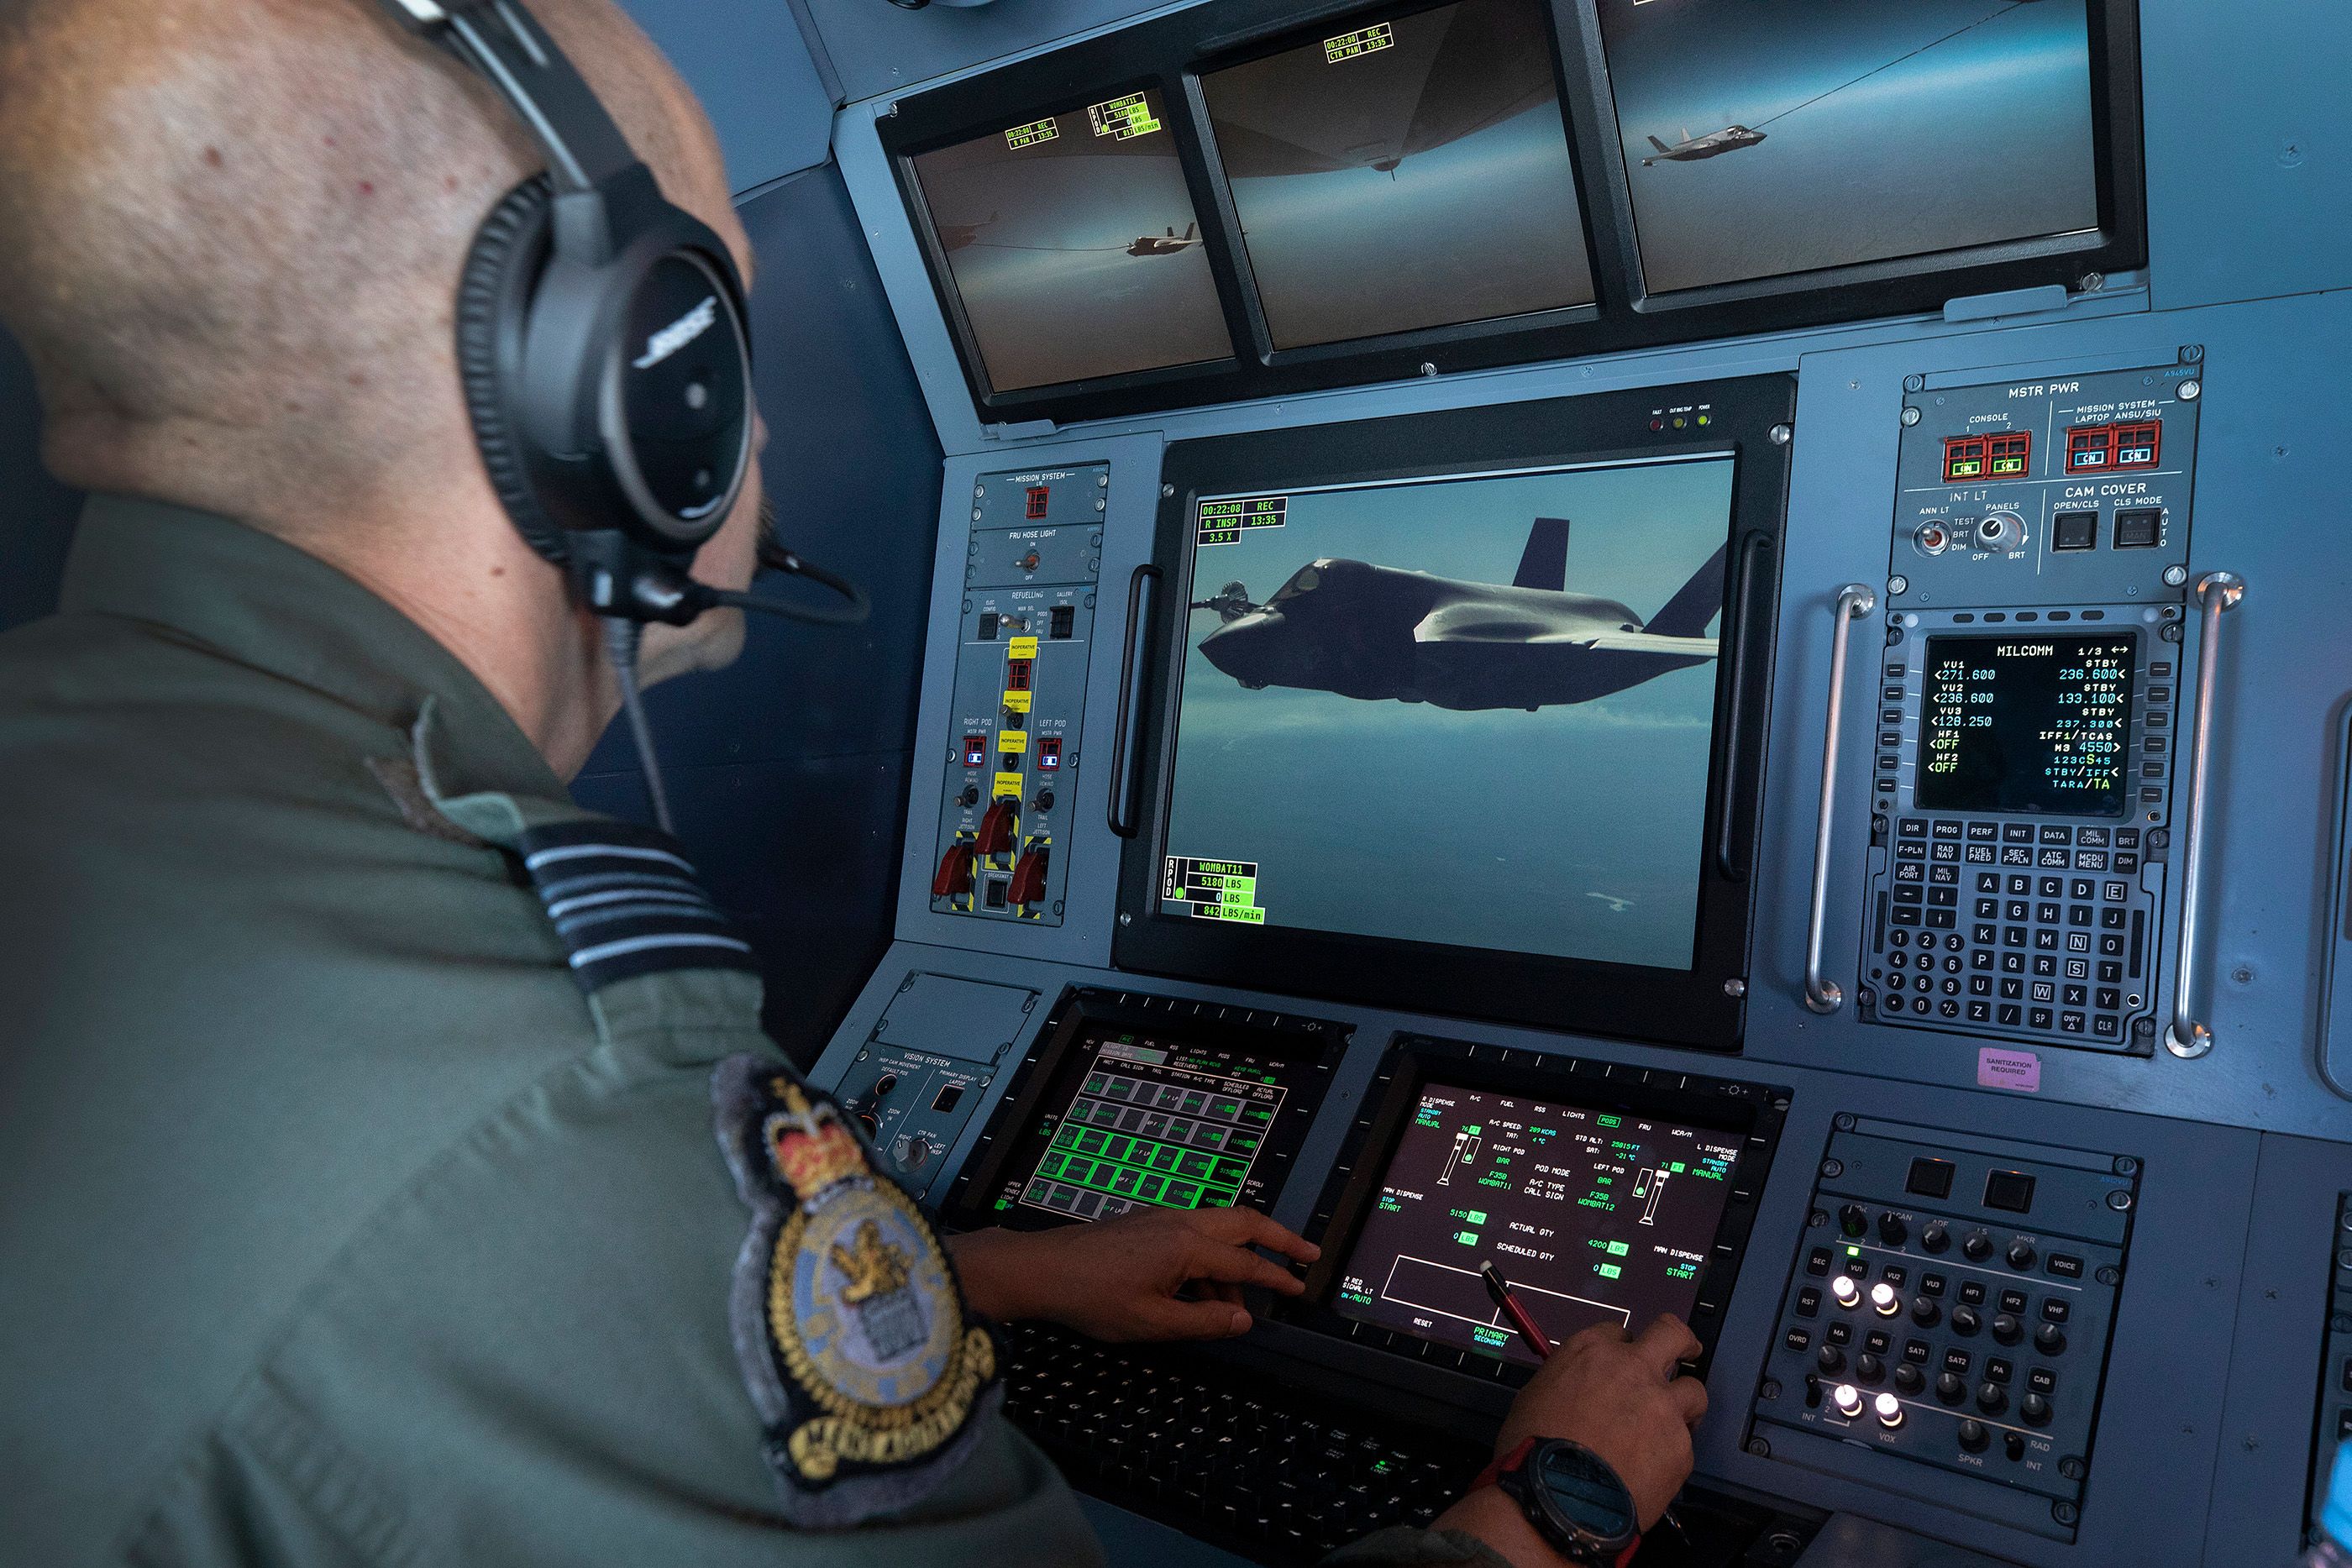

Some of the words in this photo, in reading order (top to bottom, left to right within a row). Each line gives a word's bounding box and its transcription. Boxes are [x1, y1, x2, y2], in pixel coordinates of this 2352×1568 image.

[1368, 29, 1380, 38] REC
[1367, 38, 1386, 50] 13:35
[1331, 50, 1343, 60] CTR
[1347, 45, 1358, 55] PAN
[1038, 131, 1053, 139] 13:35
[2008, 385, 2043, 398] MSTR
[2049, 382, 2079, 393] PWR
[2076, 404, 2115, 413] MISSION
[2118, 400, 2155, 410] SYSTEM
[1970, 413, 2008, 423] CONSOLE
[2076, 413, 2109, 423] LAPTOP
[2114, 409, 2161, 419] ANSU/SIU
[1042, 472, 1066, 480] SYSTEM
[2066, 486, 2095, 497] CAM
[2101, 483, 2146, 496] COVER
[1950, 492, 1969, 502] INT
[1975, 491, 1987, 501] LT
[2114, 497, 2132, 506] CLS
[2135, 496, 2162, 506] MODE
[1203, 504, 1241, 515] 00:22:08
[1257, 501, 1274, 511] REC
[1986, 502, 2019, 511] PANELS
[2054, 500, 2099, 511] OPEN/CLS
[1205, 519, 1210, 528] R
[1216, 518, 1236, 527] INSP
[1251, 515, 1276, 526] 13:35
[1210, 533, 1223, 542] 3.5
[1226, 532, 1231, 541] X
[1997, 645, 2053, 657] MILCOMM
[2078, 648, 2102, 656] 1/3
[2040, 730, 2113, 741] IFF1/TCAS
[2053, 779, 2110, 789] TARA/TA
[1906, 824, 1919, 832] DIR
[1936, 825, 1958, 834] PROG
[1971, 827, 1992, 836] PERF
[2044, 831, 2066, 840] DATA
[2081, 836, 2105, 845] COMM
[1898, 846, 1923, 854] F-PLN
[1969, 847, 1992, 855] FUEL
[1969, 853, 1992, 862] PRED
[2079, 853, 2103, 862] MCDU
[1200, 863, 1242, 874] WOMBAT11
[2078, 860, 2103, 868] MENU
[1202, 877, 1222, 887] 5180
[1226, 879, 1242, 888] LBS
[1225, 894, 1240, 903] LBS
[1204, 906, 1220, 915] 842
[1223, 908, 1260, 920] LBS/min
[2098, 1020, 2112, 1031] CLR
[904, 1052, 924, 1062] VISION
[926, 1057, 951, 1067] SYSTEM
[1986, 1057, 2032, 1068] SANITIZATION
[939, 1070, 958, 1078] PRIMARY
[958, 1073, 977, 1082] DISPLAY
[1991, 1066, 2026, 1076] REQUIRED
[1415, 1119, 1441, 1129] MANUAL
[1493, 1144, 1511, 1153] RIGHT
[1535, 1164, 1549, 1172] POD
[1551, 1167, 1570, 1177] MODE
[1593, 1163, 1610, 1172] LEFT
[1693, 1168, 1724, 1181] MANUAL
[1478, 1178, 1512, 1190] WOMBAT11
[1525, 1187, 1542, 1197] CALL
[1546, 1193, 1564, 1202] SIGN
[1379, 1203, 1401, 1212] START
[1578, 1198, 1615, 1211] WOMBAT12
[1450, 1209, 1467, 1218] 5150
[1509, 1222, 1536, 1234] ACTUAL
[1540, 1228, 1554, 1237] QTY
[1588, 1240, 1607, 1249] 4200
[1497, 1243, 1536, 1257] SCHEDULED
[1540, 1252, 1554, 1261] QTY
[1813, 1257, 1825, 1266] SEC
[2054, 1260, 2076, 1271] VOICE
[1851, 1264, 1862, 1272] VU1
[1667, 1268, 1693, 1280] START
[1887, 1272, 1900, 1281] VU2
[1926, 1280, 1939, 1289] VU3
[1802, 1297, 1814, 1306] RST
[2049, 1305, 2064, 1314] VHF
[1414, 1318, 1432, 1328] RESET
[1473, 1327, 1509, 1341] PRIMARY
[1788, 1335, 1807, 1345] OVRD
[1908, 1347, 1925, 1356] SAT1
[1948, 1356, 1966, 1366] SAT2
[2034, 1375, 2050, 1386] CAB
[1802, 1413, 1816, 1423] INT
[1879, 1433, 1896, 1444] VOX
[2030, 1440, 2050, 1452] RAD
[1958, 1455, 1983, 1467] SPKR
[2026, 1460, 2042, 1471] INT
